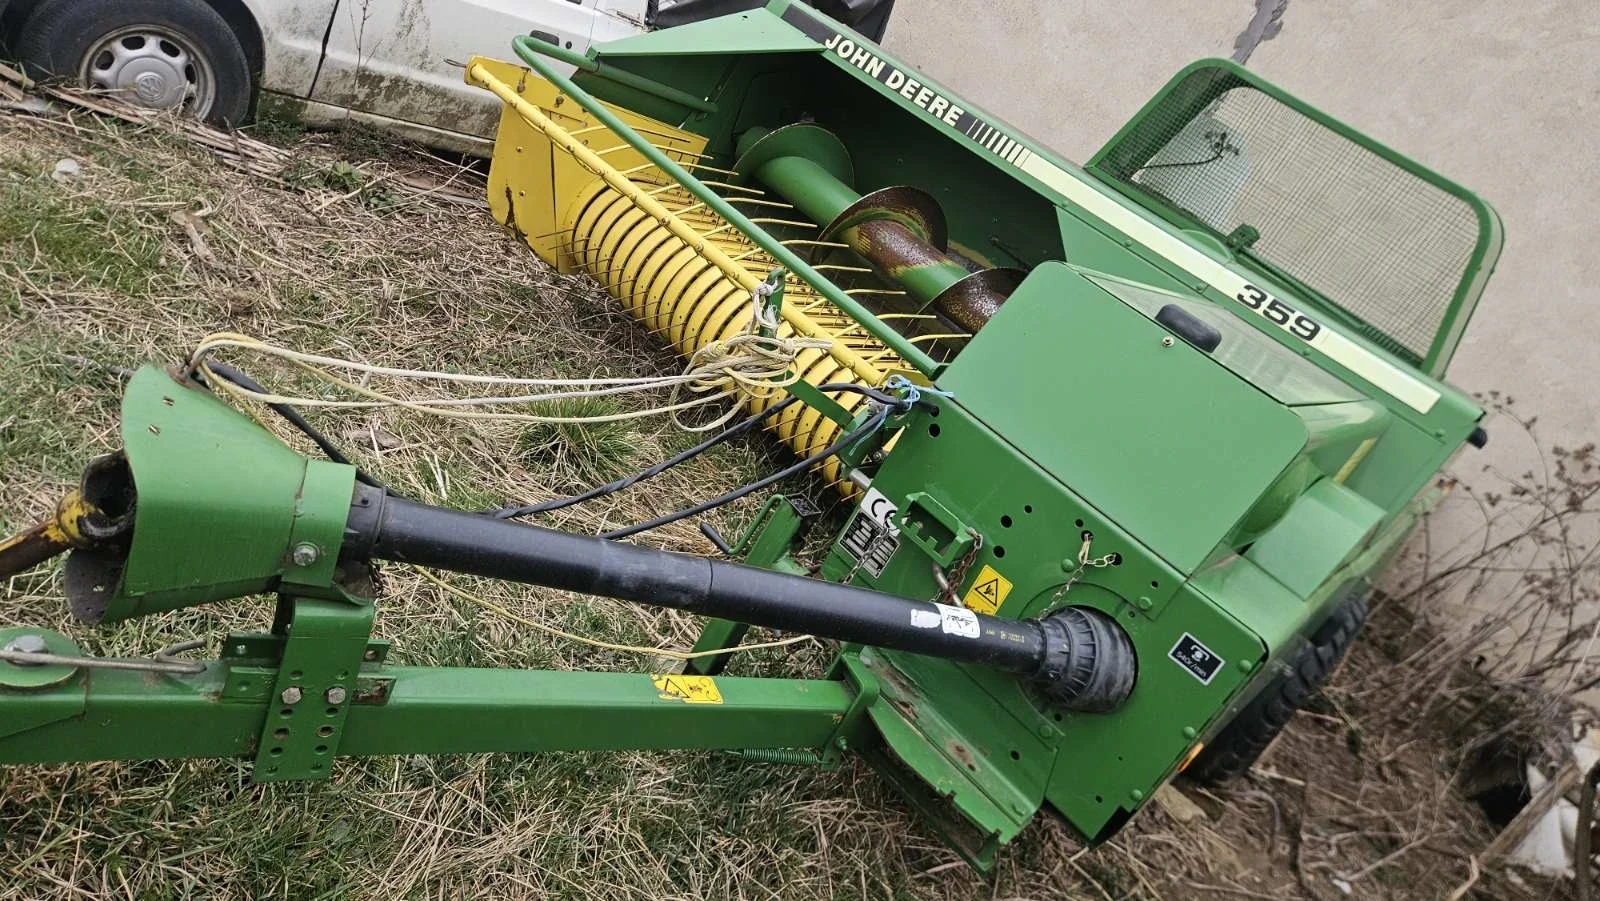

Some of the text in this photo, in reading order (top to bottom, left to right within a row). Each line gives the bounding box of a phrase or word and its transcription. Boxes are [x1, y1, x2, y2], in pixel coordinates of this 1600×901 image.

[825, 34, 964, 127] JOHN DEERE
[1237, 284, 1321, 341] 359
